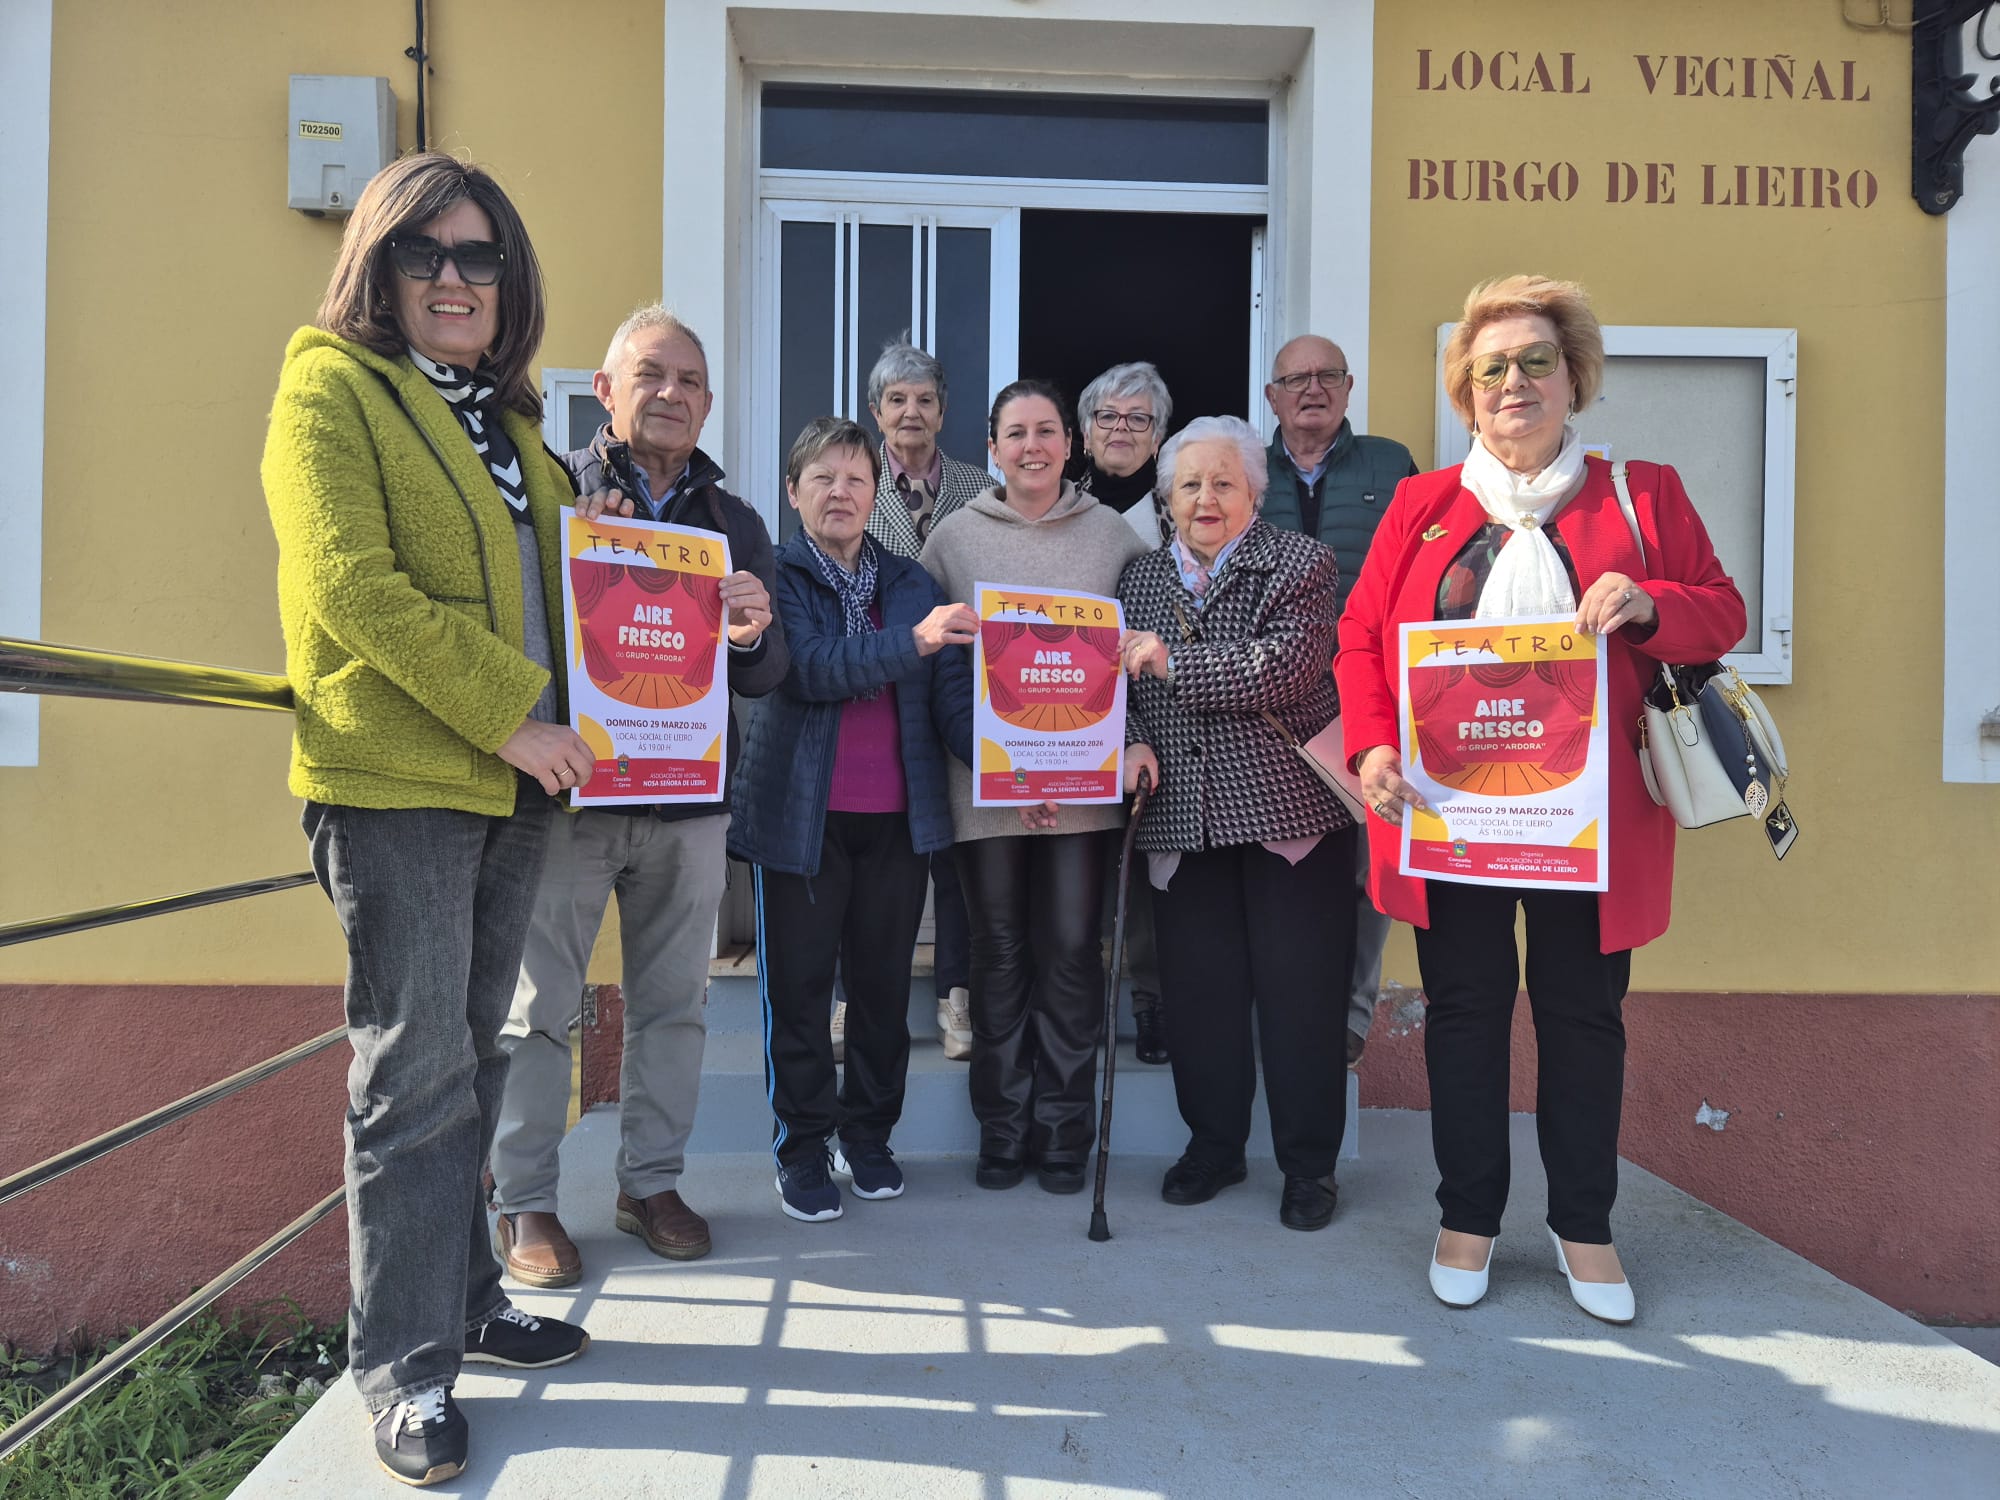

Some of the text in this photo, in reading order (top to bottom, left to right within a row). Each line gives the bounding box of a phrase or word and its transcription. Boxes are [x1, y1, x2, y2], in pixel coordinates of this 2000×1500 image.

[1416, 48, 1871, 101] LOCAL VECIÑAL
[301, 124, 340, 136] T022500
[1407, 158, 1878, 209] BURGO DE LIEIRO
[587, 535, 710, 567] TEATRO
[633, 603, 673, 626] AIRE
[998, 601, 1104, 620] TEATRO
[618, 625, 685, 650] FRESCO
[1428, 634, 1573, 658] TEATRO
[625, 651, 650, 660] GRUPO
[1033, 649, 1072, 665] AIRE
[1020, 667, 1086, 684] FRESCO
[1474, 698, 1525, 718] AIRE
[606, 718, 707, 730] DOMINGO 29 MARZO 2026
[1458, 720, 1544, 740] FRESCO
[616, 733, 637, 741] LOCAL
[639, 733, 661, 742] SOCIAL
[1456, 743, 1467, 751] do
[1468, 743, 1498, 751] GRUPO
[660, 779, 681, 787] SEÑORA
[1442, 806, 1574, 816] DOMINGO 29 MARZO 2026
[1452, 818, 1553, 828] LOCAL SOCIAL DE LIEIRO
[1492, 828, 1514, 837] 19.00
[1533, 857, 1543, 865] DE
[1510, 863, 1540, 872] SEÑORA
[1553, 865, 1579, 874] LIEIRO
